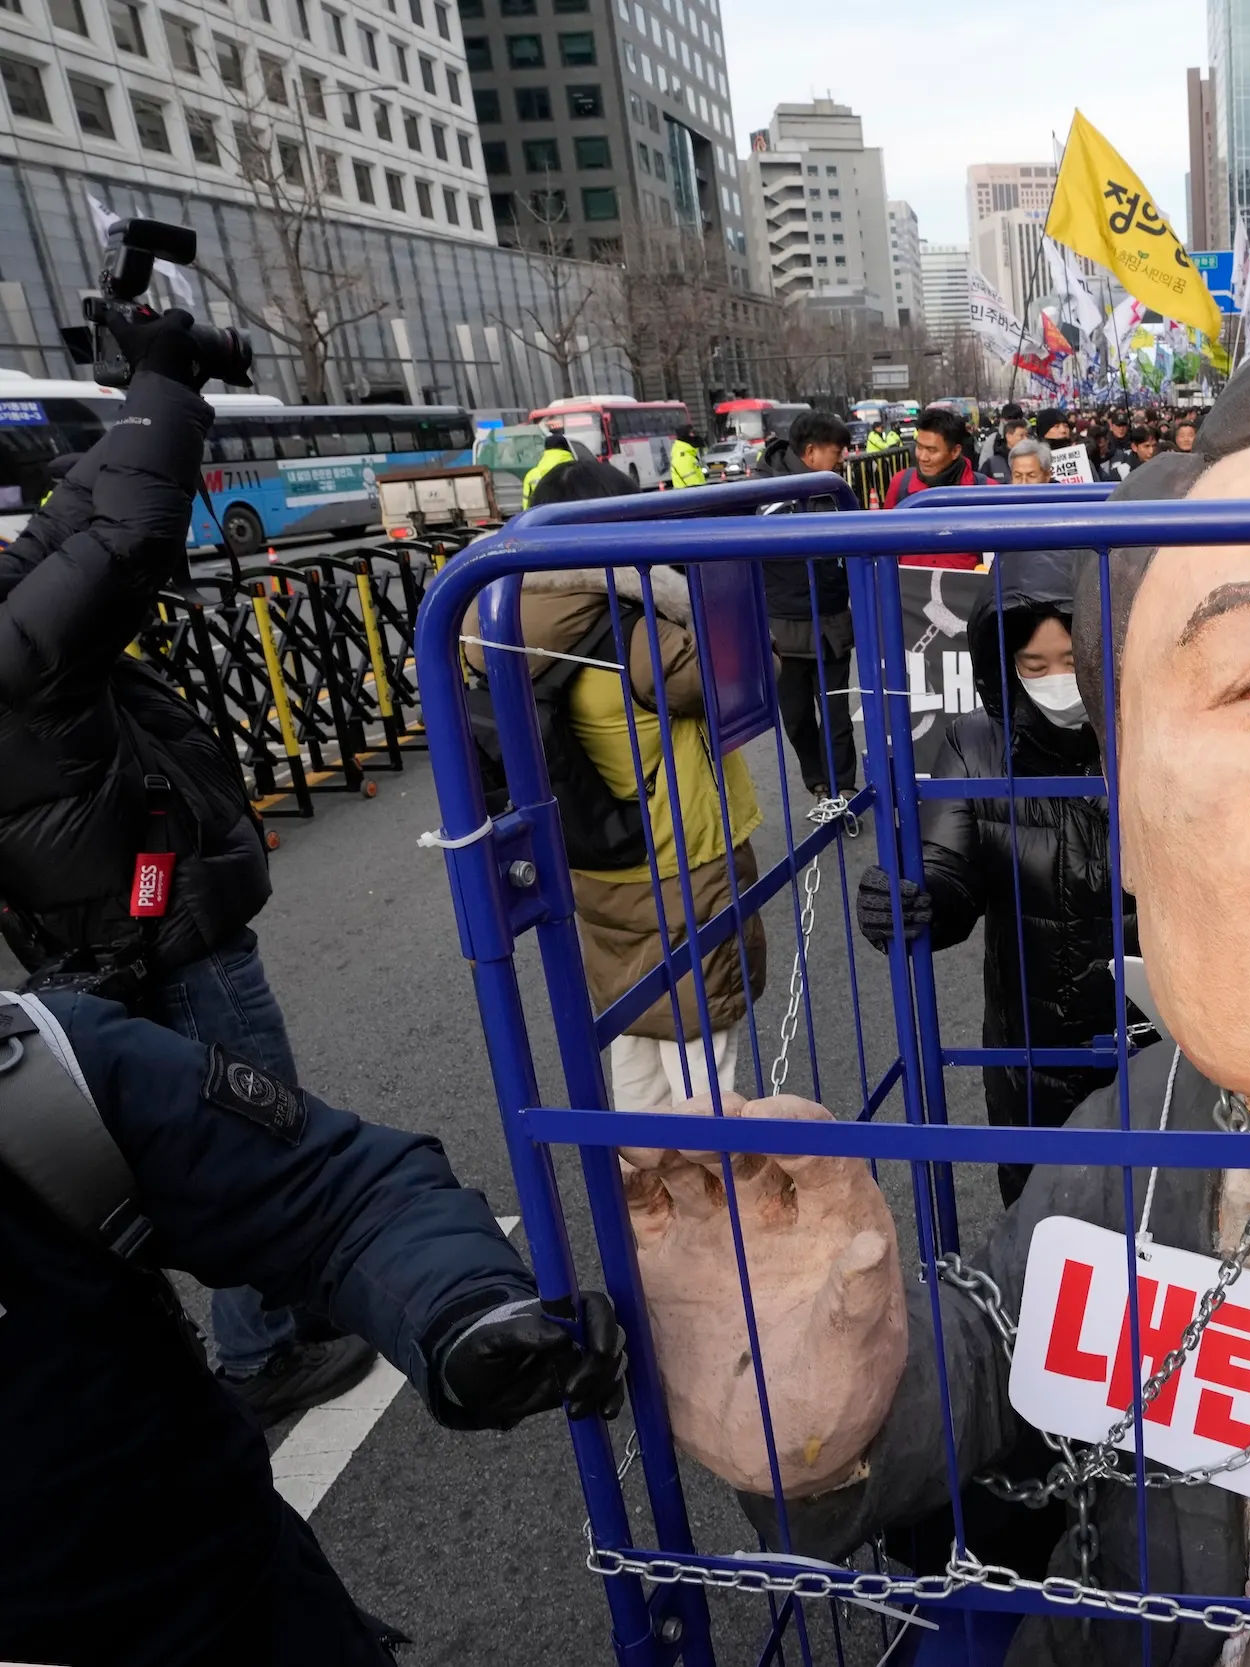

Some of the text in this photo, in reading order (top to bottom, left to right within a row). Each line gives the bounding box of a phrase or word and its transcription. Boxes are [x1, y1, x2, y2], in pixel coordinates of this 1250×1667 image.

[1104, 180, 1190, 268] 정의
[1117, 249, 1187, 294] 희망 시민의 꿈
[205, 469, 262, 493] M7111
[138, 865, 157, 907] PRESS
